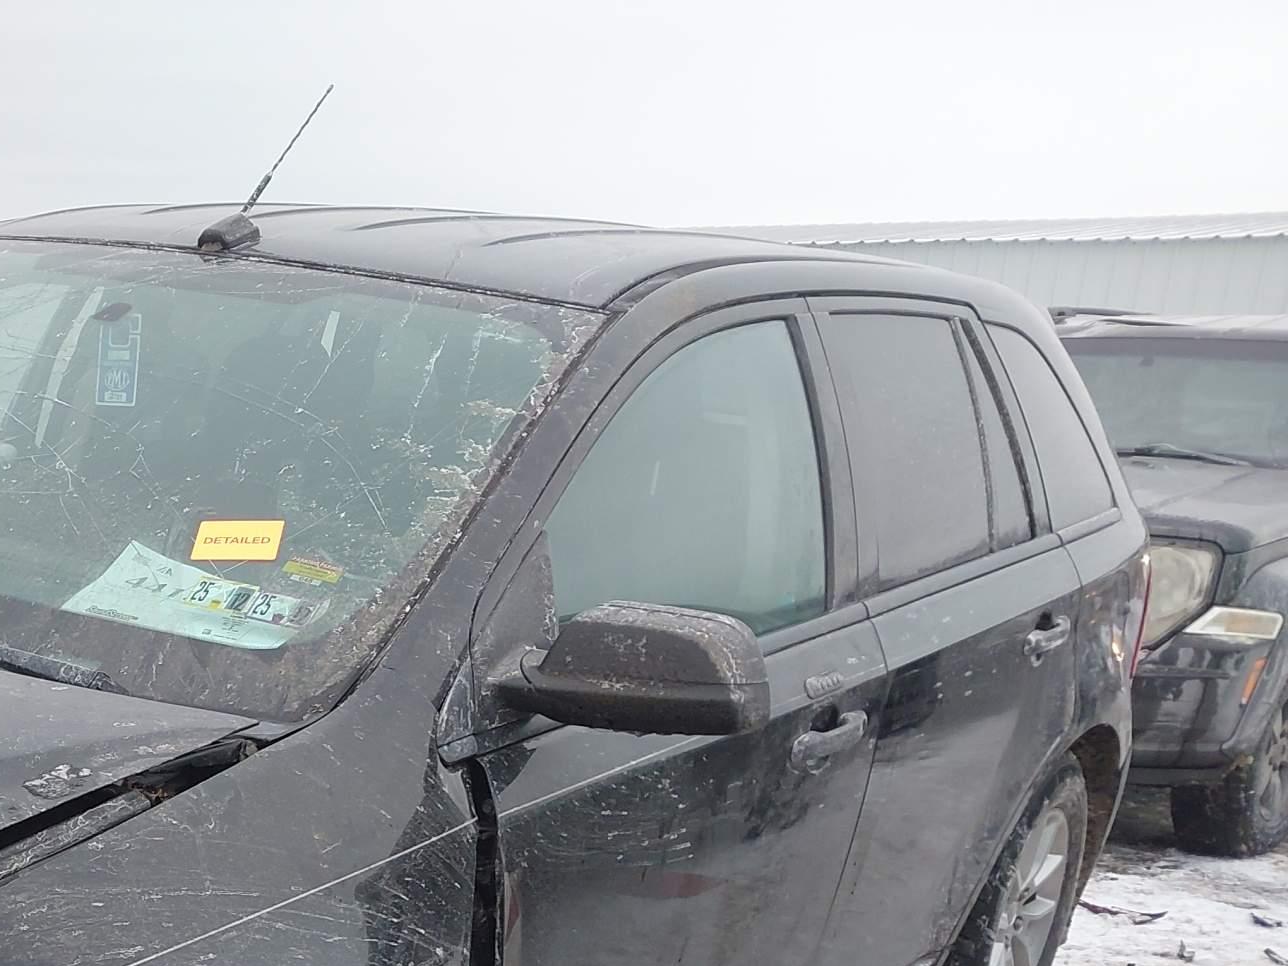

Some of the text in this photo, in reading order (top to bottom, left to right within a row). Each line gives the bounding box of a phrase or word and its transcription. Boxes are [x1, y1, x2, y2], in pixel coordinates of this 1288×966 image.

[203, 536, 272, 545] DETAILED
[191, 580, 215, 602] 25
[252, 593, 277, 616] 25
